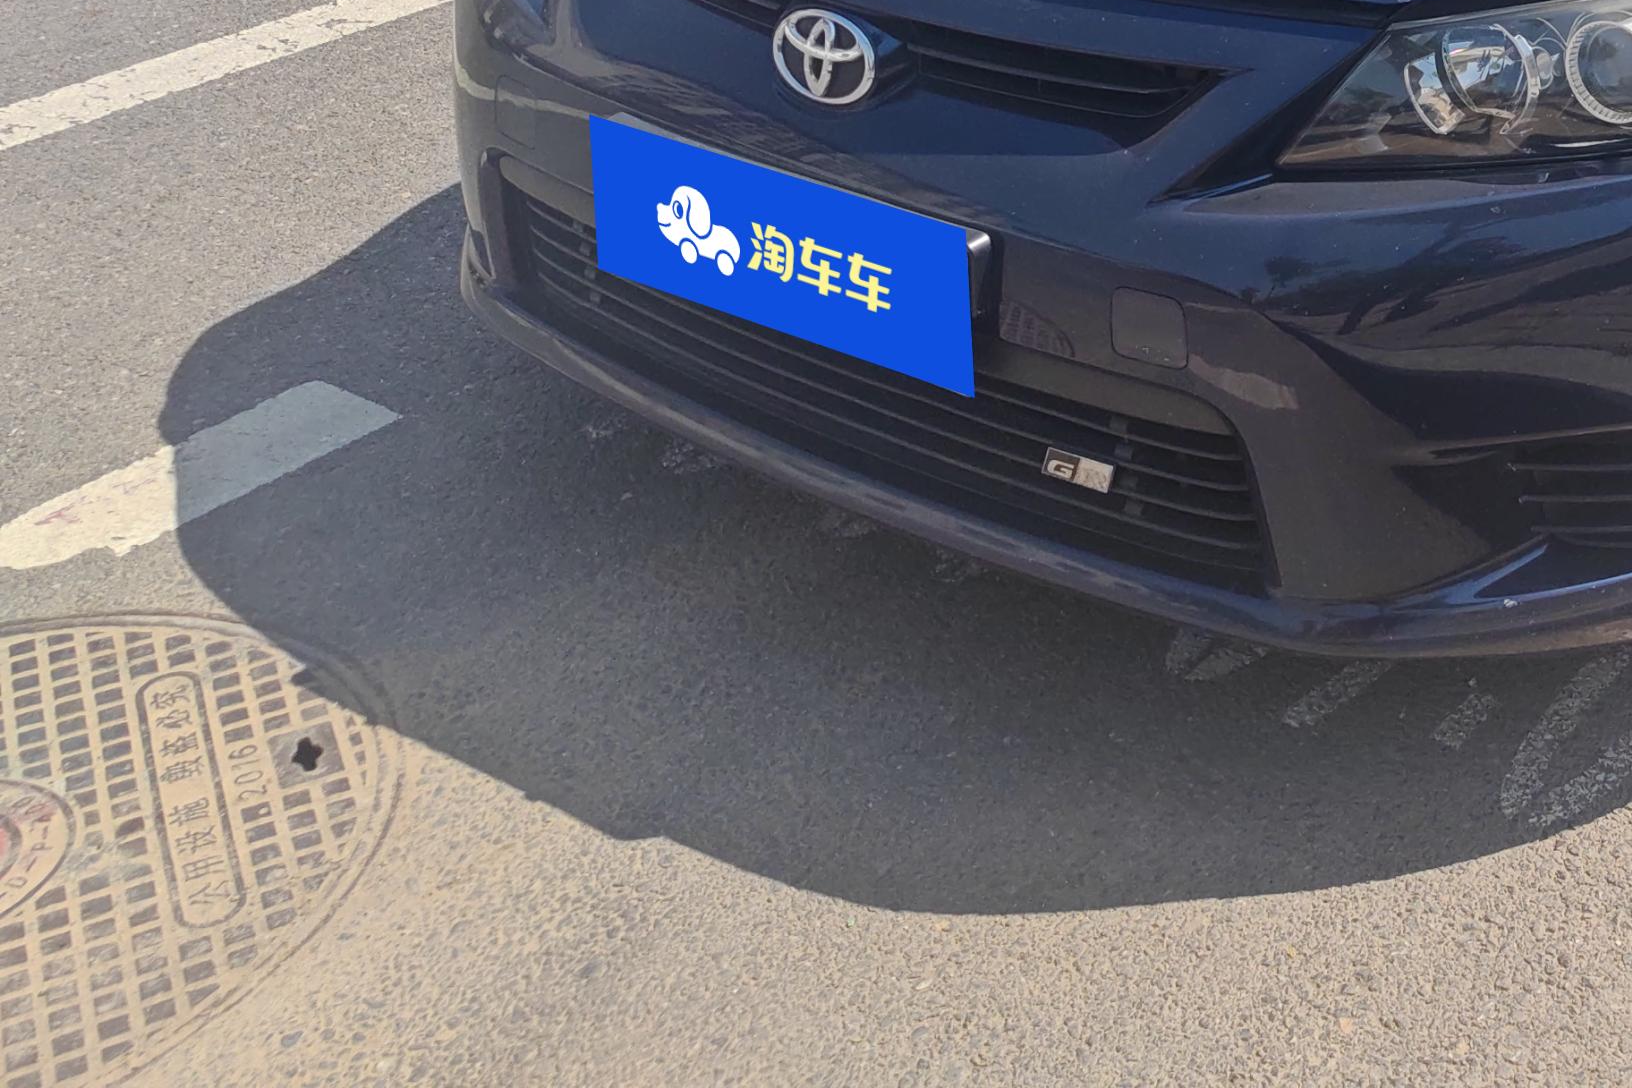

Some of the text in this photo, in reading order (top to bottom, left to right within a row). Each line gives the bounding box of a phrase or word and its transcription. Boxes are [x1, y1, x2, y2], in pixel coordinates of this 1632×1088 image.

[228, 744, 267, 801] 2016
[168, 797, 231, 906] 公用设施
